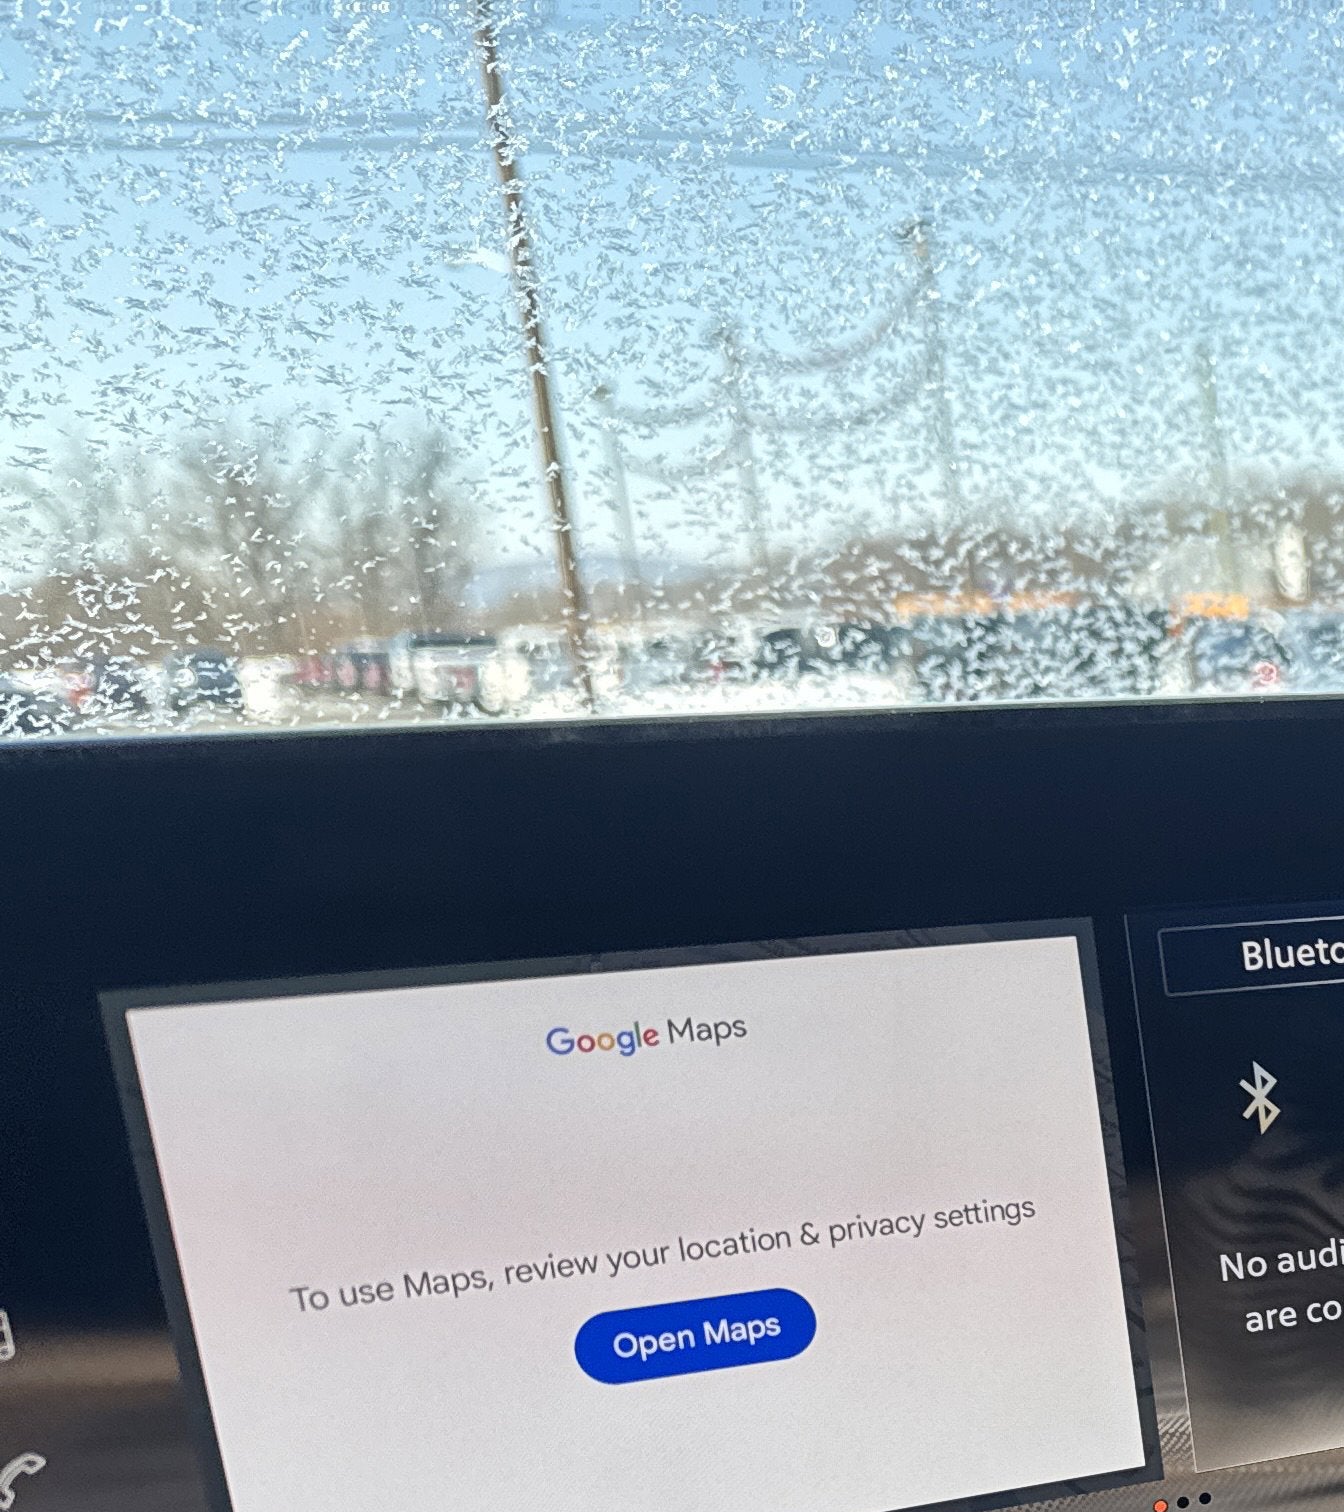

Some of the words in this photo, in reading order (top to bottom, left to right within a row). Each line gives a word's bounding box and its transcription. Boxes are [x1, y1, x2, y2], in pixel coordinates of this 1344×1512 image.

[546, 1021, 660, 1056] Google
[666, 1015, 747, 1047] Maps
[290, 1283, 330, 1314] To
[338, 1275, 395, 1307] use
[404, 1263, 494, 1299] Maps,
[504, 1250, 598, 1286] review
[605, 1240, 669, 1279] your
[678, 1226, 791, 1261] location
[799, 1221, 821, 1246] &
[828, 1210, 925, 1248] privacy
[933, 1198, 1036, 1230] settings
[1219, 1253, 1267, 1282] No
[612, 1327, 695, 1361] Open
[703, 1314, 781, 1346] Maps
[1244, 1306, 1298, 1333] are
